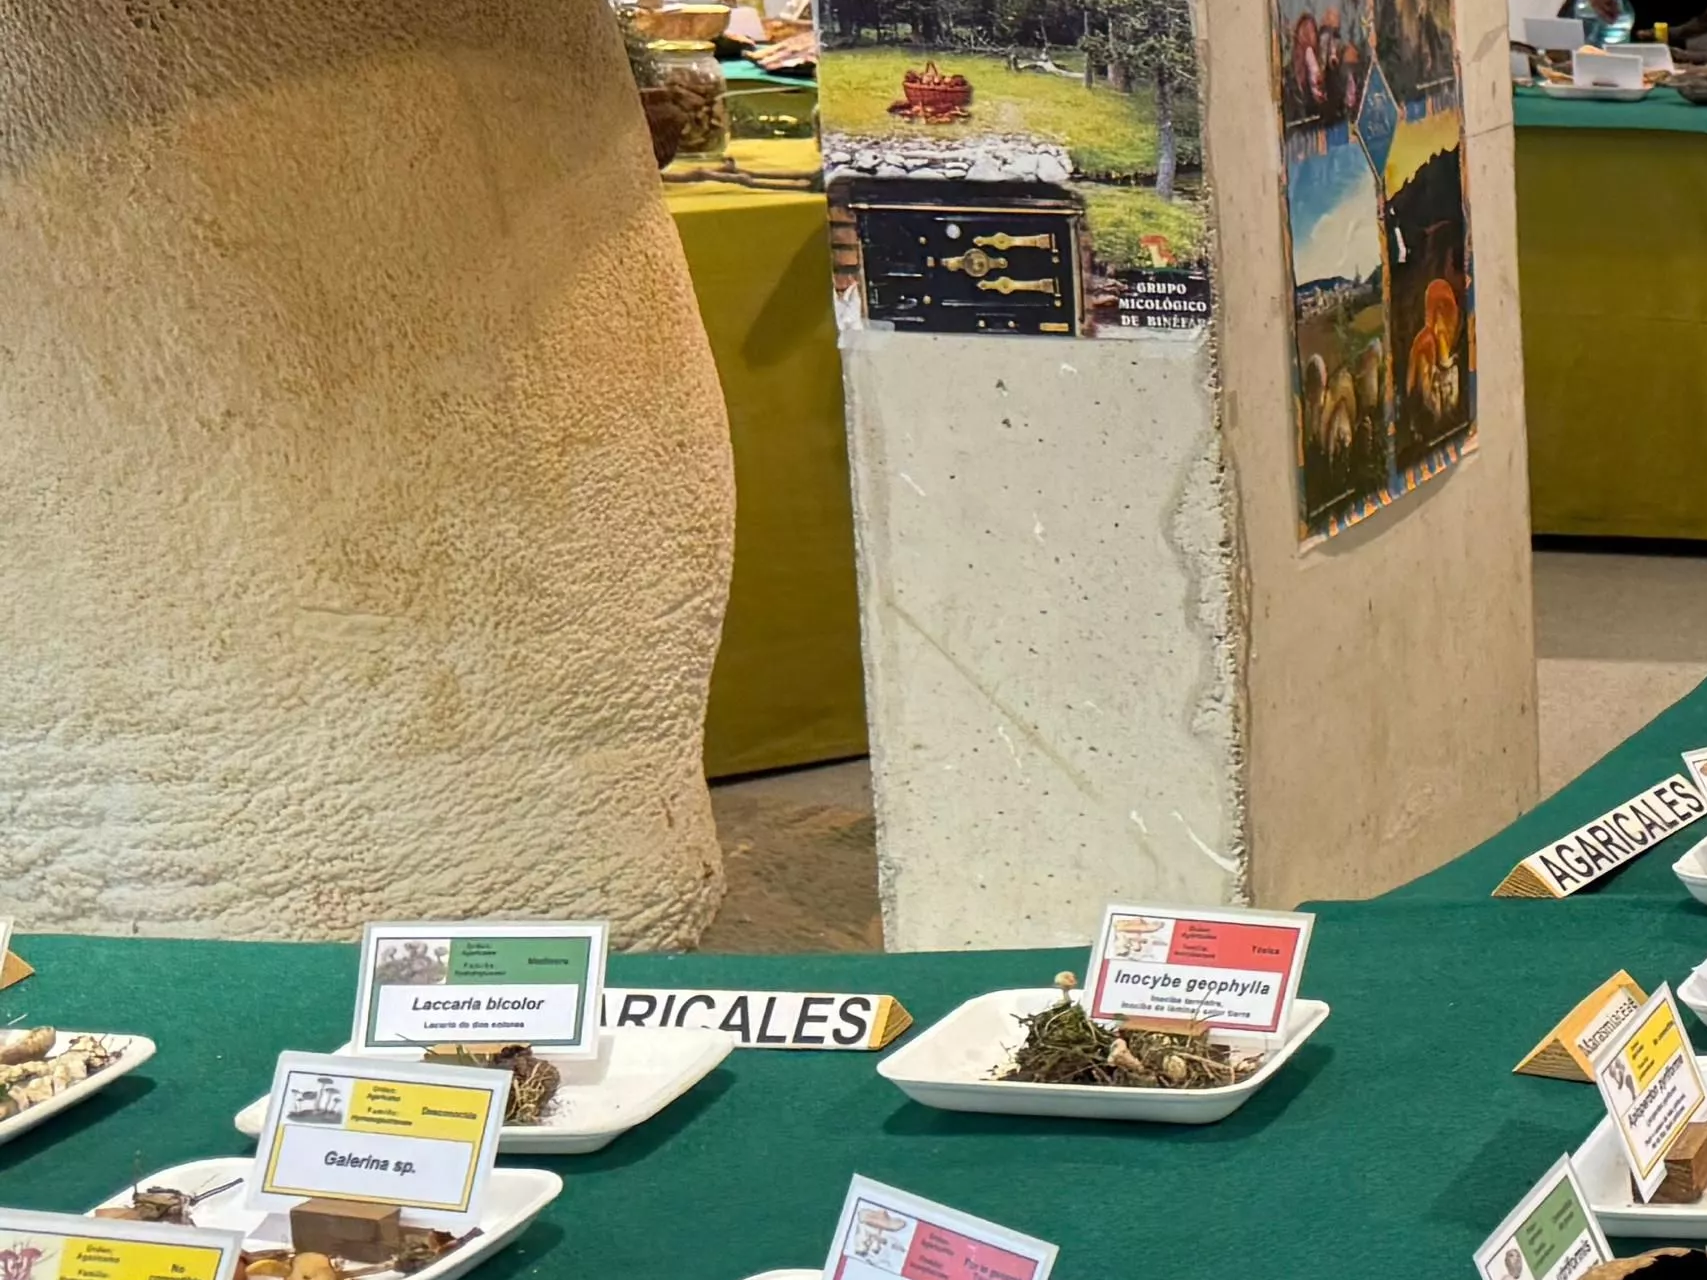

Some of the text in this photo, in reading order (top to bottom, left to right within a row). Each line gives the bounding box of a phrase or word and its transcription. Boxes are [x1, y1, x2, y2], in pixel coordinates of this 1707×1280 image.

[1136, 282, 1187, 295] GRUPO
[1118, 298, 1207, 312] MICOLÓGICO
[1121, 315, 1139, 327] DE
[1539, 780, 1705, 891] AGARICALES
[1114, 969, 1271, 998] Inocybe geophylla
[412, 996, 546, 1012] Laccaria bicolor
[601, 994, 871, 1044] RICALES
[324, 1150, 416, 1177] Galerina sp.
